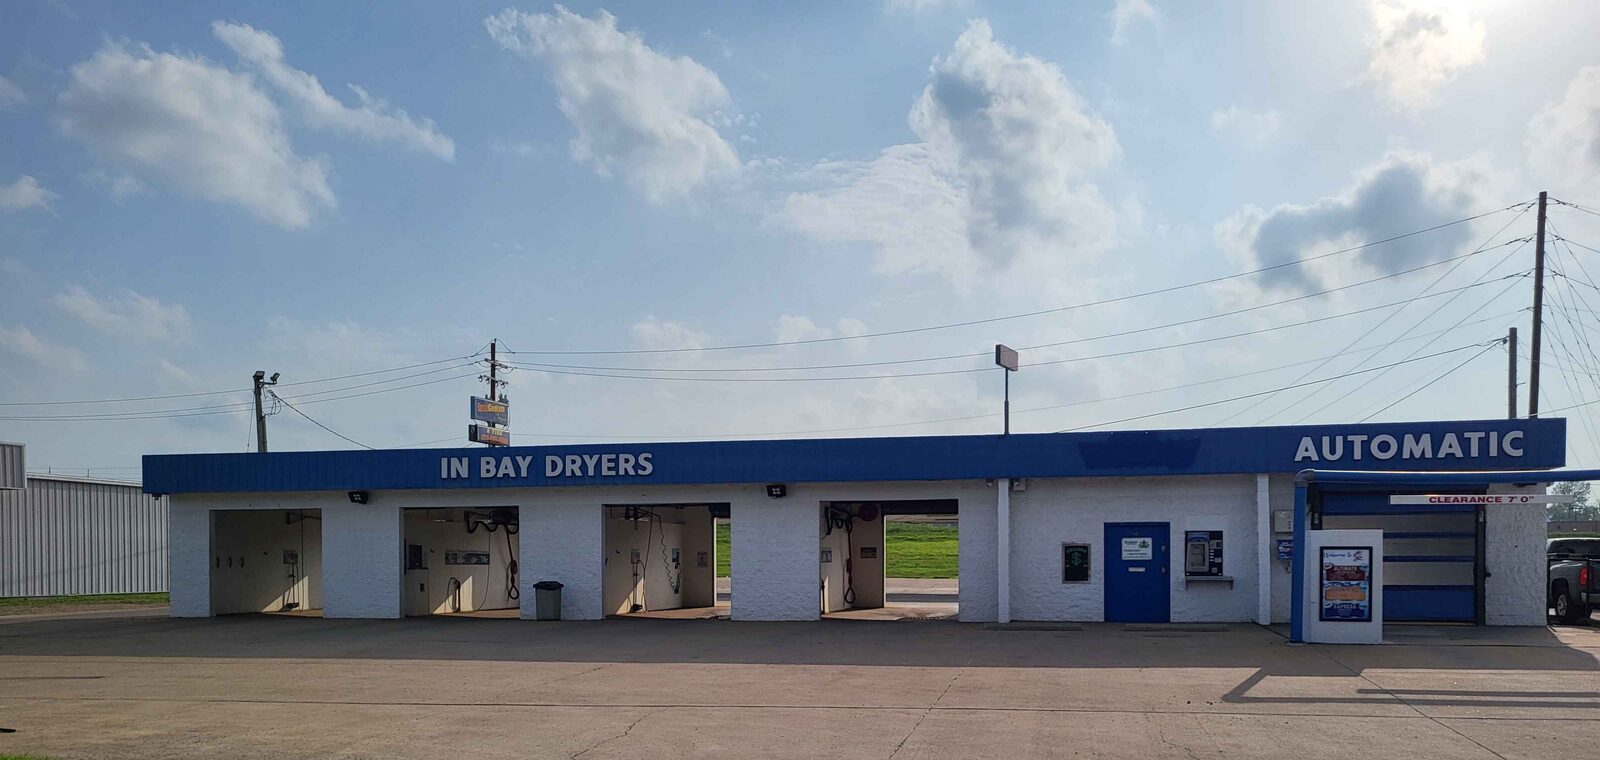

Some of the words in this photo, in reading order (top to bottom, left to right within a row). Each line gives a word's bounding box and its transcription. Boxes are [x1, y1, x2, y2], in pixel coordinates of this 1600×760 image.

[1295, 431, 1523, 461] AUTOMATIC
[441, 457, 469, 479] IN
[480, 455, 533, 478] BAY
[545, 452, 653, 478] DRYERS
